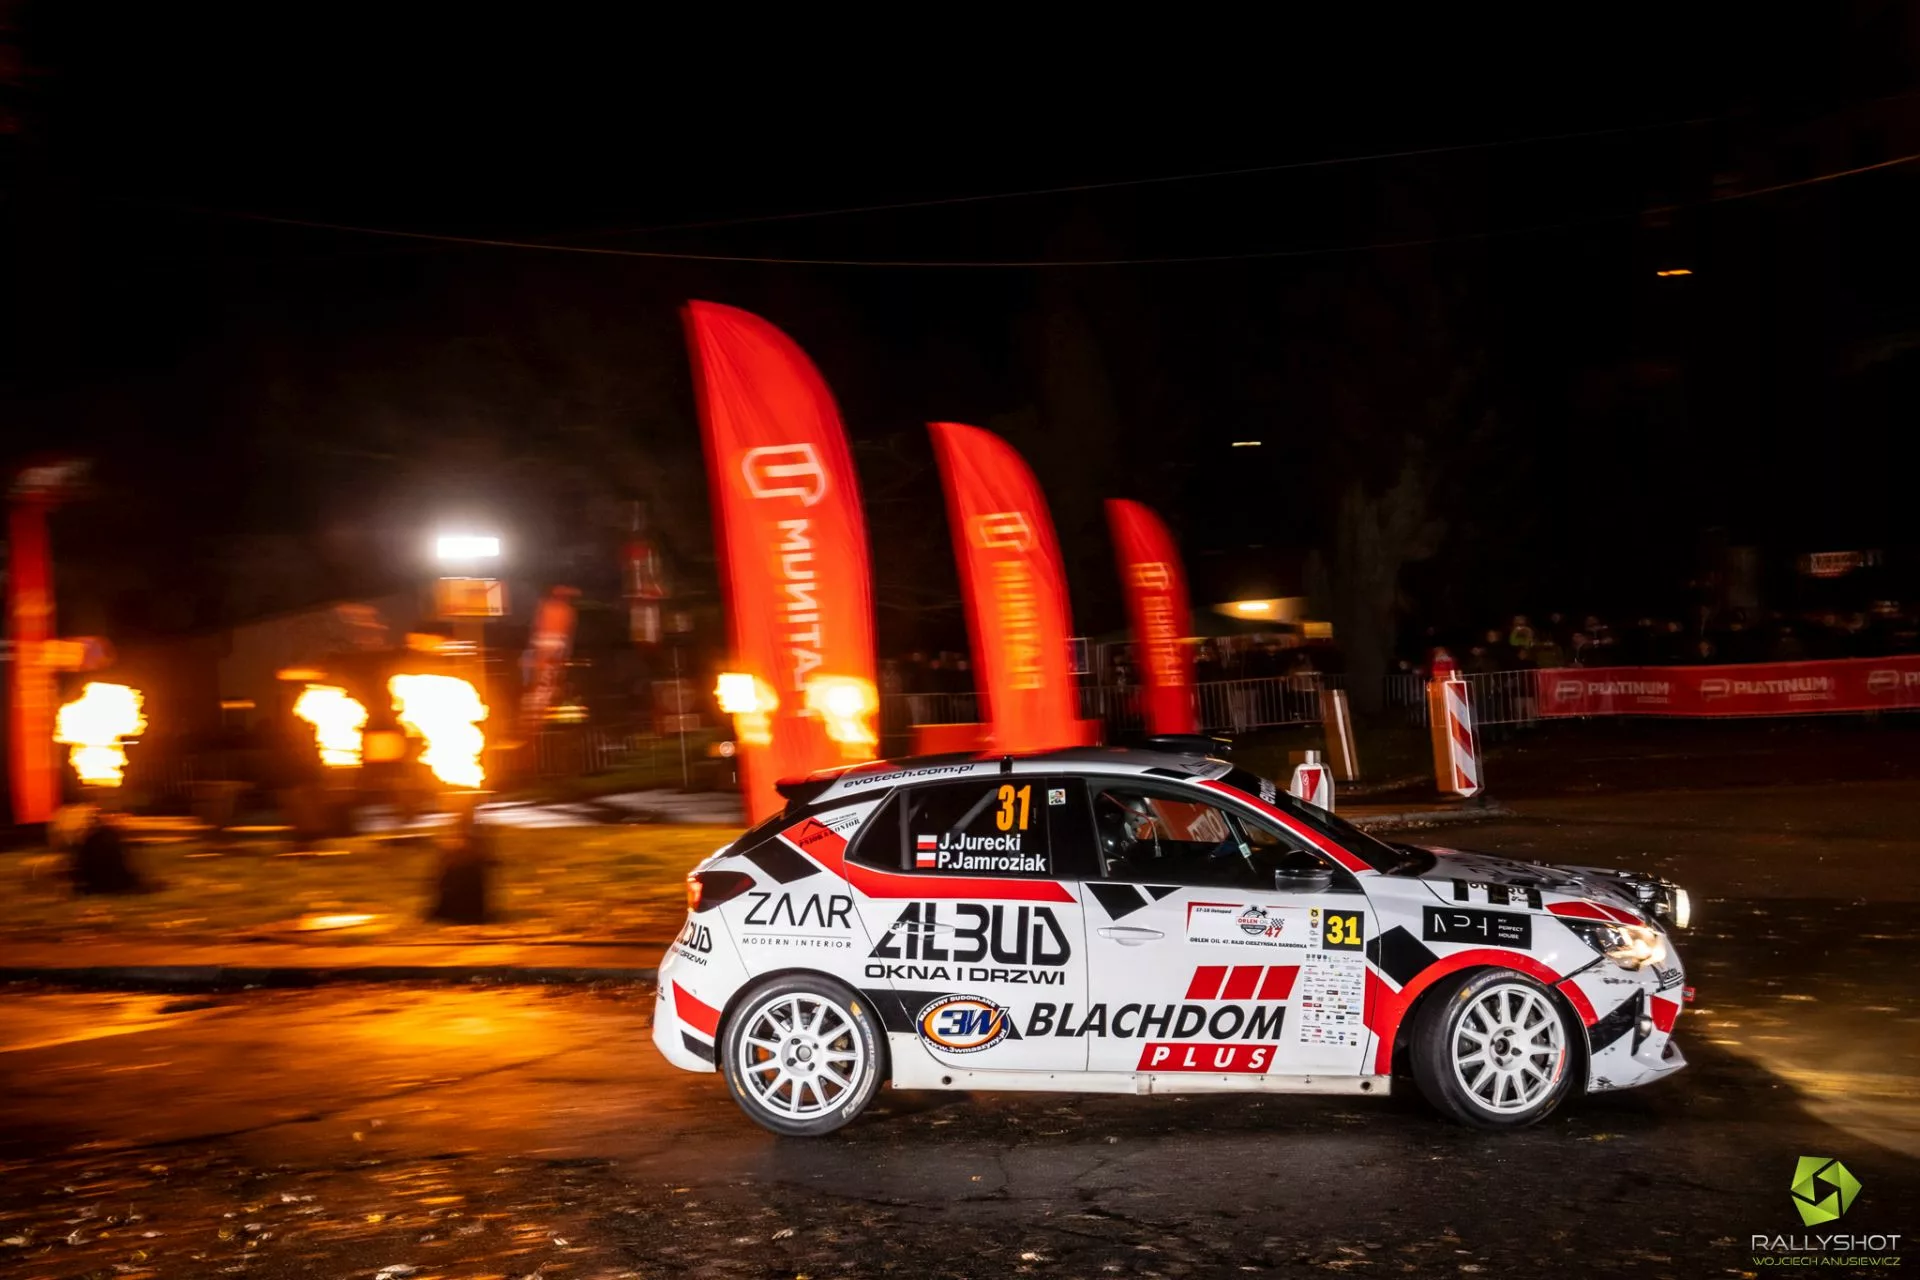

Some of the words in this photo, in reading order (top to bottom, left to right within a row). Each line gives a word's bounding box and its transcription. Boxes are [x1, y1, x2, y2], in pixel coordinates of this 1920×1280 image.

[1588, 680, 1670, 696] PLATINUM
[1733, 676, 1829, 695] PLATINUM
[843, 763, 976, 789] evotech.com.pl
[996, 784, 1031, 831] 31
[939, 832, 1021, 851] J.Jurecki
[938, 851, 1047, 871] P.Jamroziak
[744, 892, 853, 929] ZAAR
[677, 920, 712, 954] BUD
[742, 938, 789, 946] MODERN
[796, 939, 852, 948] INTERIOR
[867, 901, 1072, 966] ALBUD
[1264, 926, 1283, 938] 47
[1326, 915, 1361, 945] 31
[680, 950, 708, 966] DRZWI
[864, 964, 951, 980] OKNA
[957, 967, 962, 981] I
[969, 968, 1065, 985] DRZWI
[919, 998, 948, 1021] MASZYNY
[950, 995, 997, 1008] BUDOWLANE
[1025, 1002, 1287, 1040] BLACHDOM
[938, 1006, 1010, 1037] 3W
[924, 1028, 1007, 1054] www.3wmaszyny.pl
[1150, 1046, 1267, 1069] PLUS
